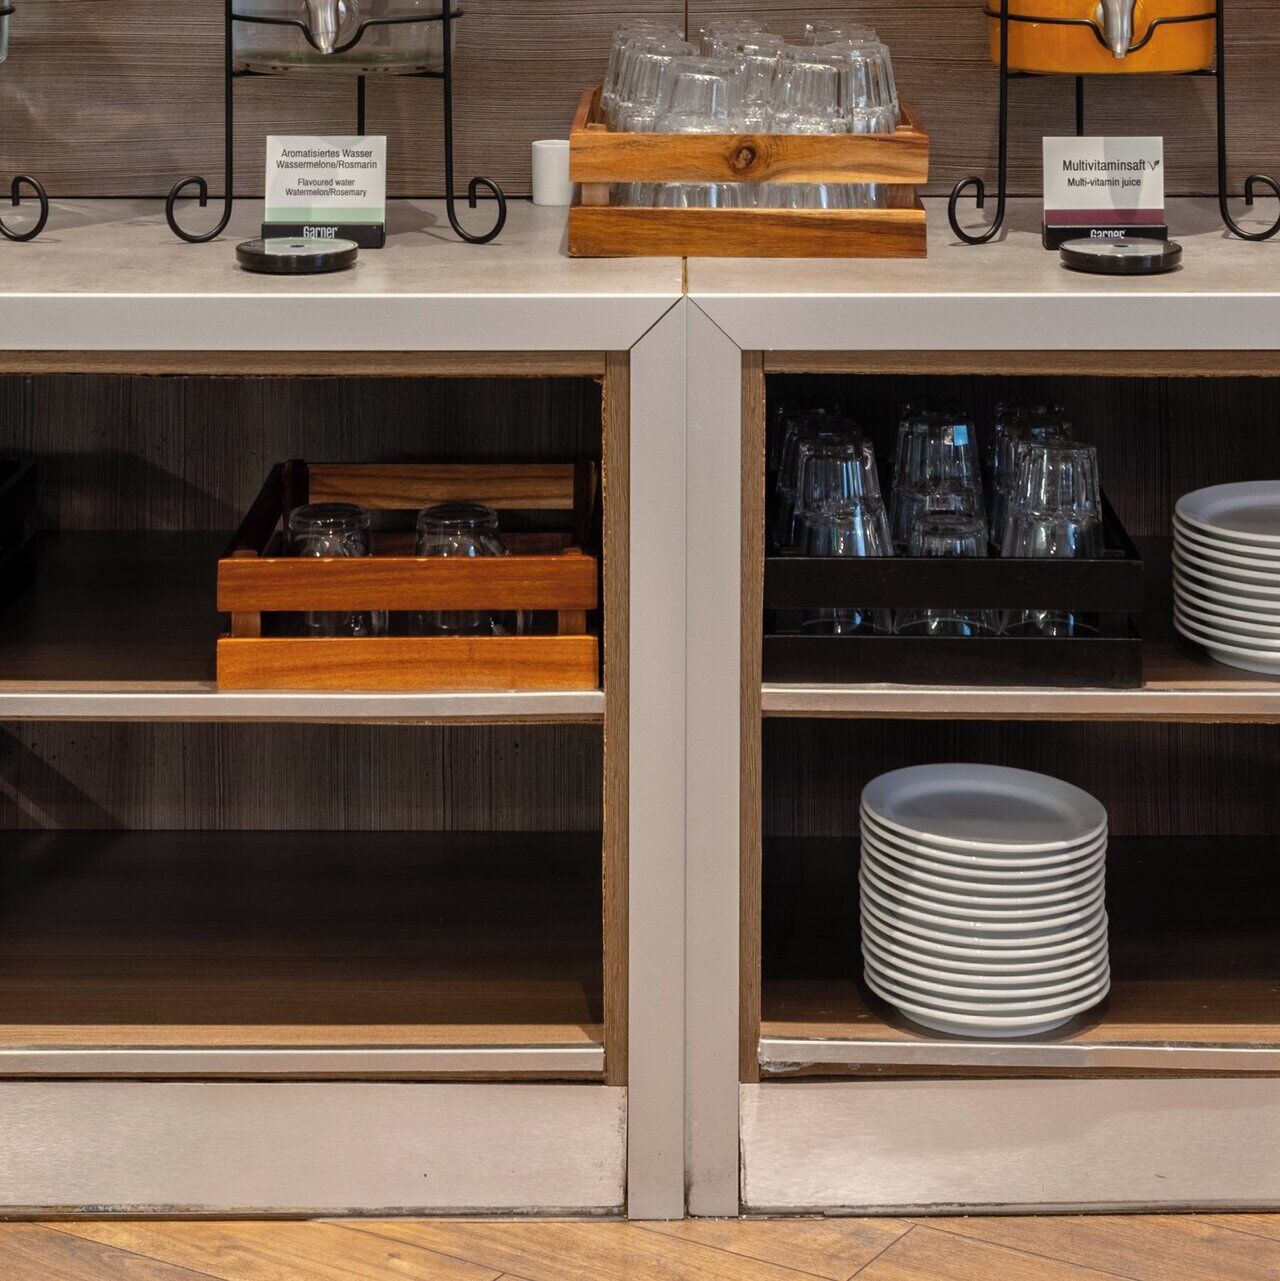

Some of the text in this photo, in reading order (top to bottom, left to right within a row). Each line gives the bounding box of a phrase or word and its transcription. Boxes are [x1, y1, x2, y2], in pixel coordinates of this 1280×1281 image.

[281, 149, 373, 158] Aromatisiertes Wasser
[276, 160, 378, 169] Wassermelone/Rosmarin
[1062, 159, 1146, 171] Multivitaminsaft
[297, 178, 334, 187] Flavoured
[1067, 177, 1142, 189] Multi-vitamin juice
[285, 188, 367, 198] Watermelon/Rosemary
[303, 225, 338, 239] Garner
